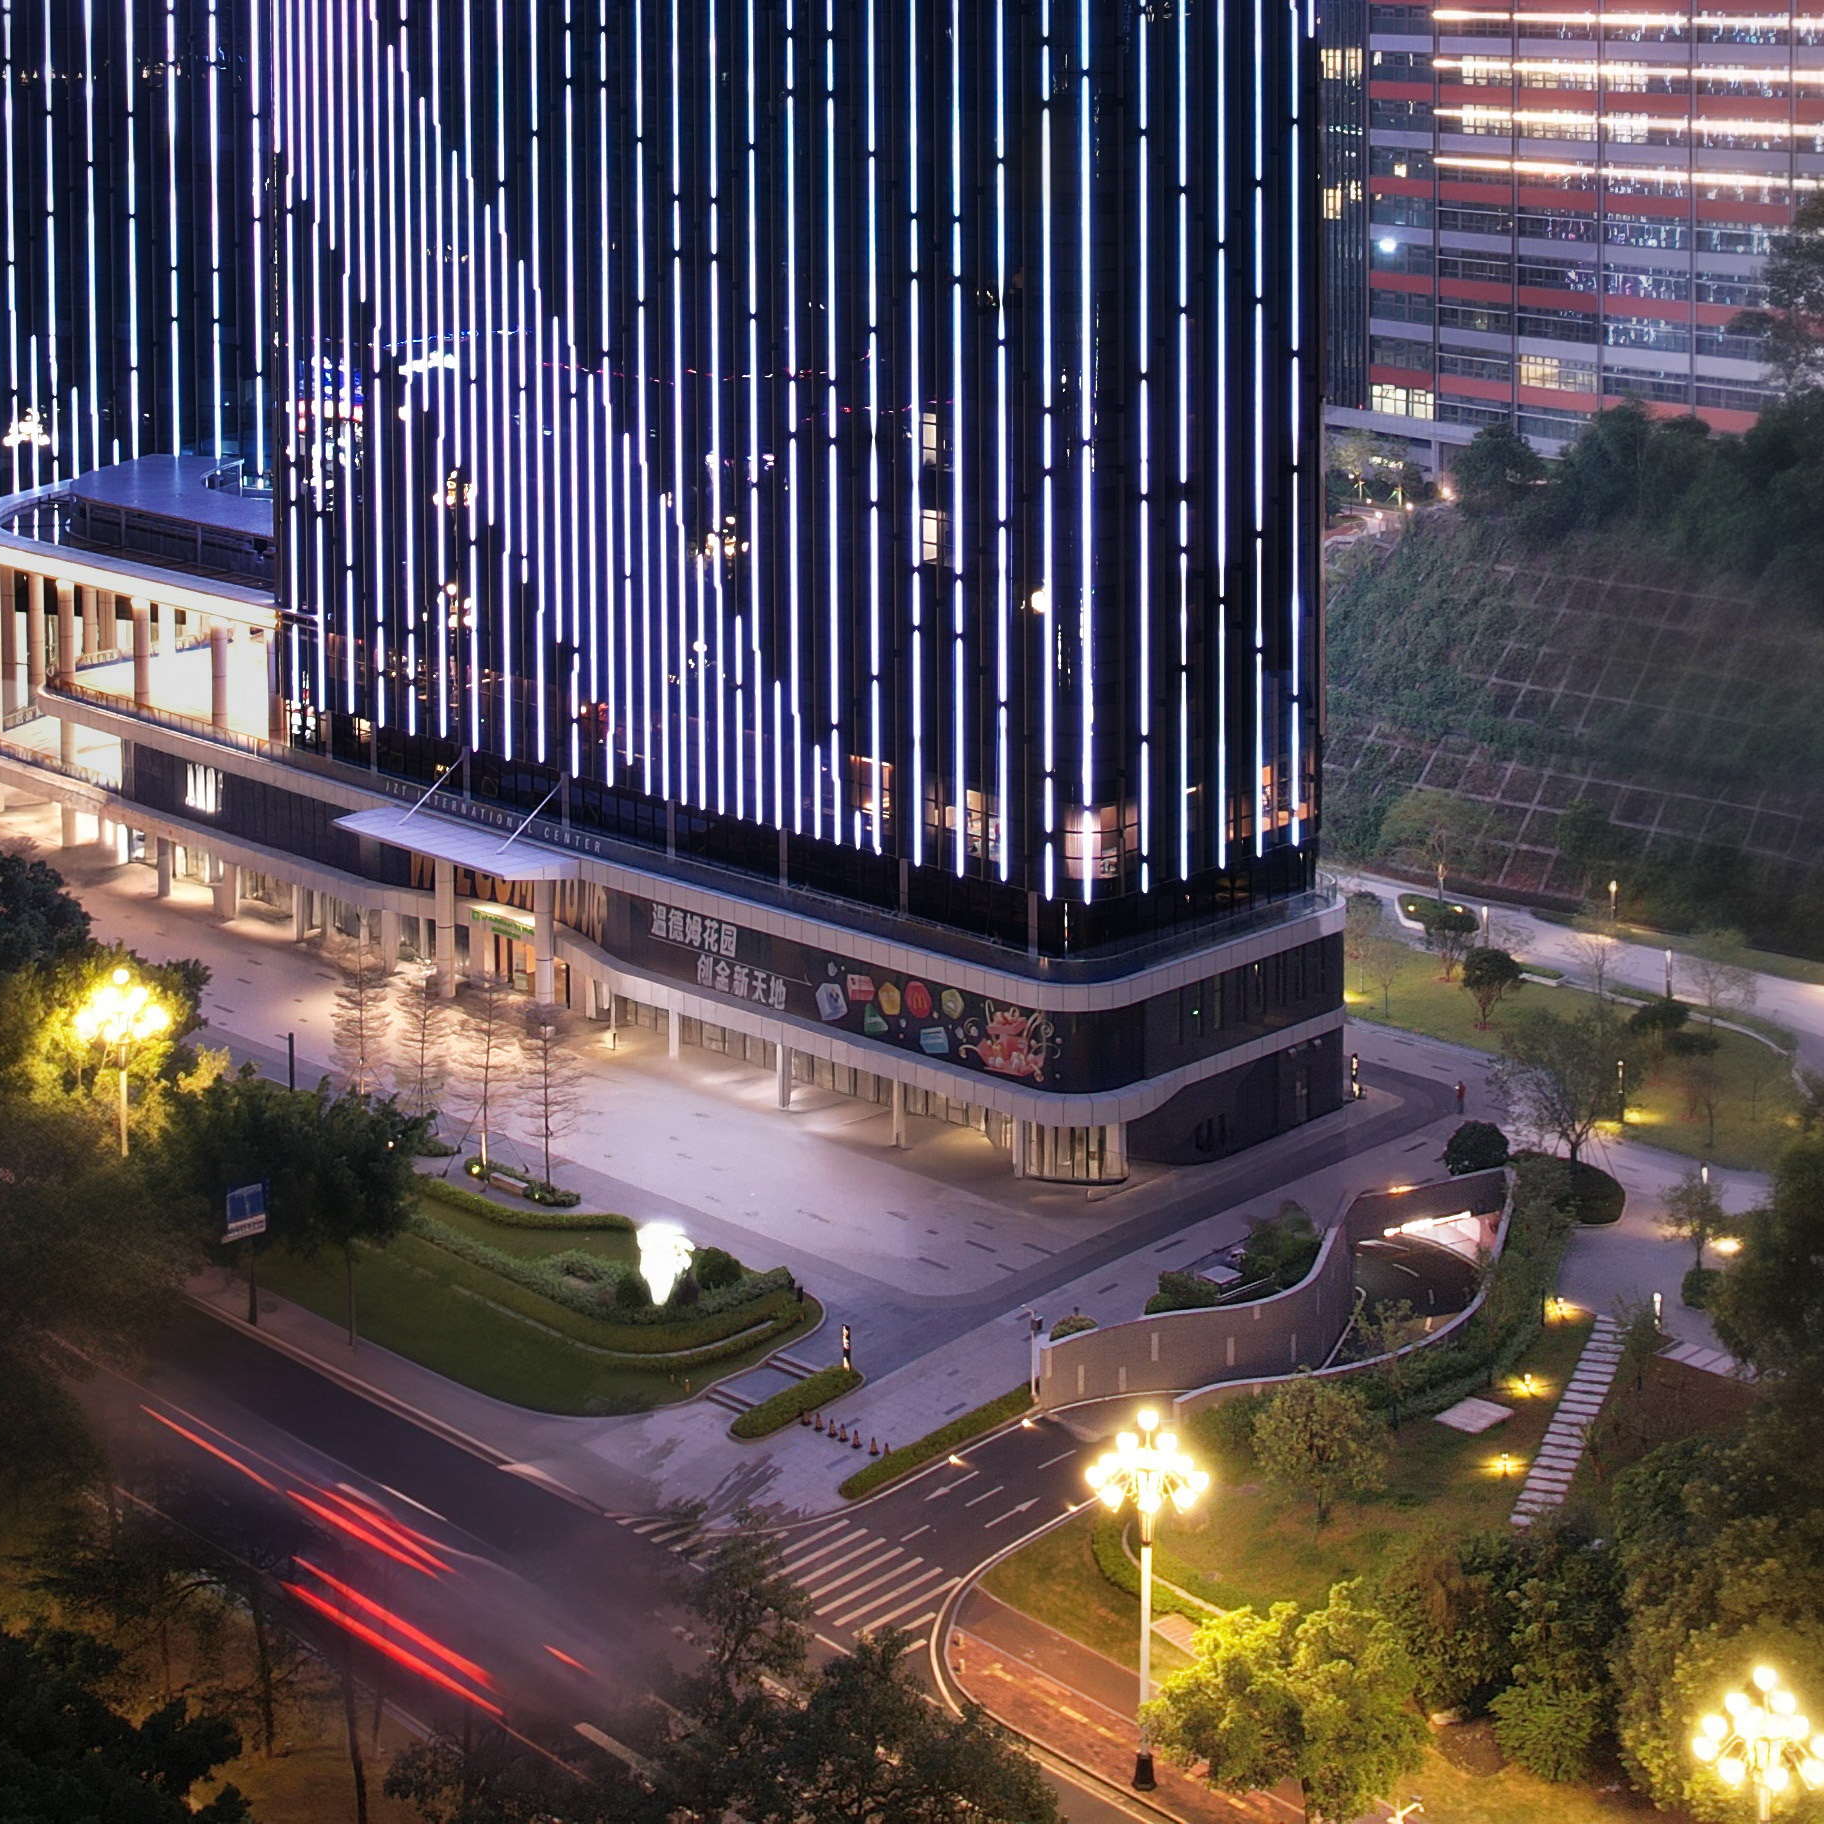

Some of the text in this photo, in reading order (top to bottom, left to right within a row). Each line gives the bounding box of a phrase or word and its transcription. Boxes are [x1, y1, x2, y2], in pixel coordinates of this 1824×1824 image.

[385, 780, 407, 796] JZT
[544, 826, 601, 853] CENTER
[651, 903, 737, 958] 温德姆花园
